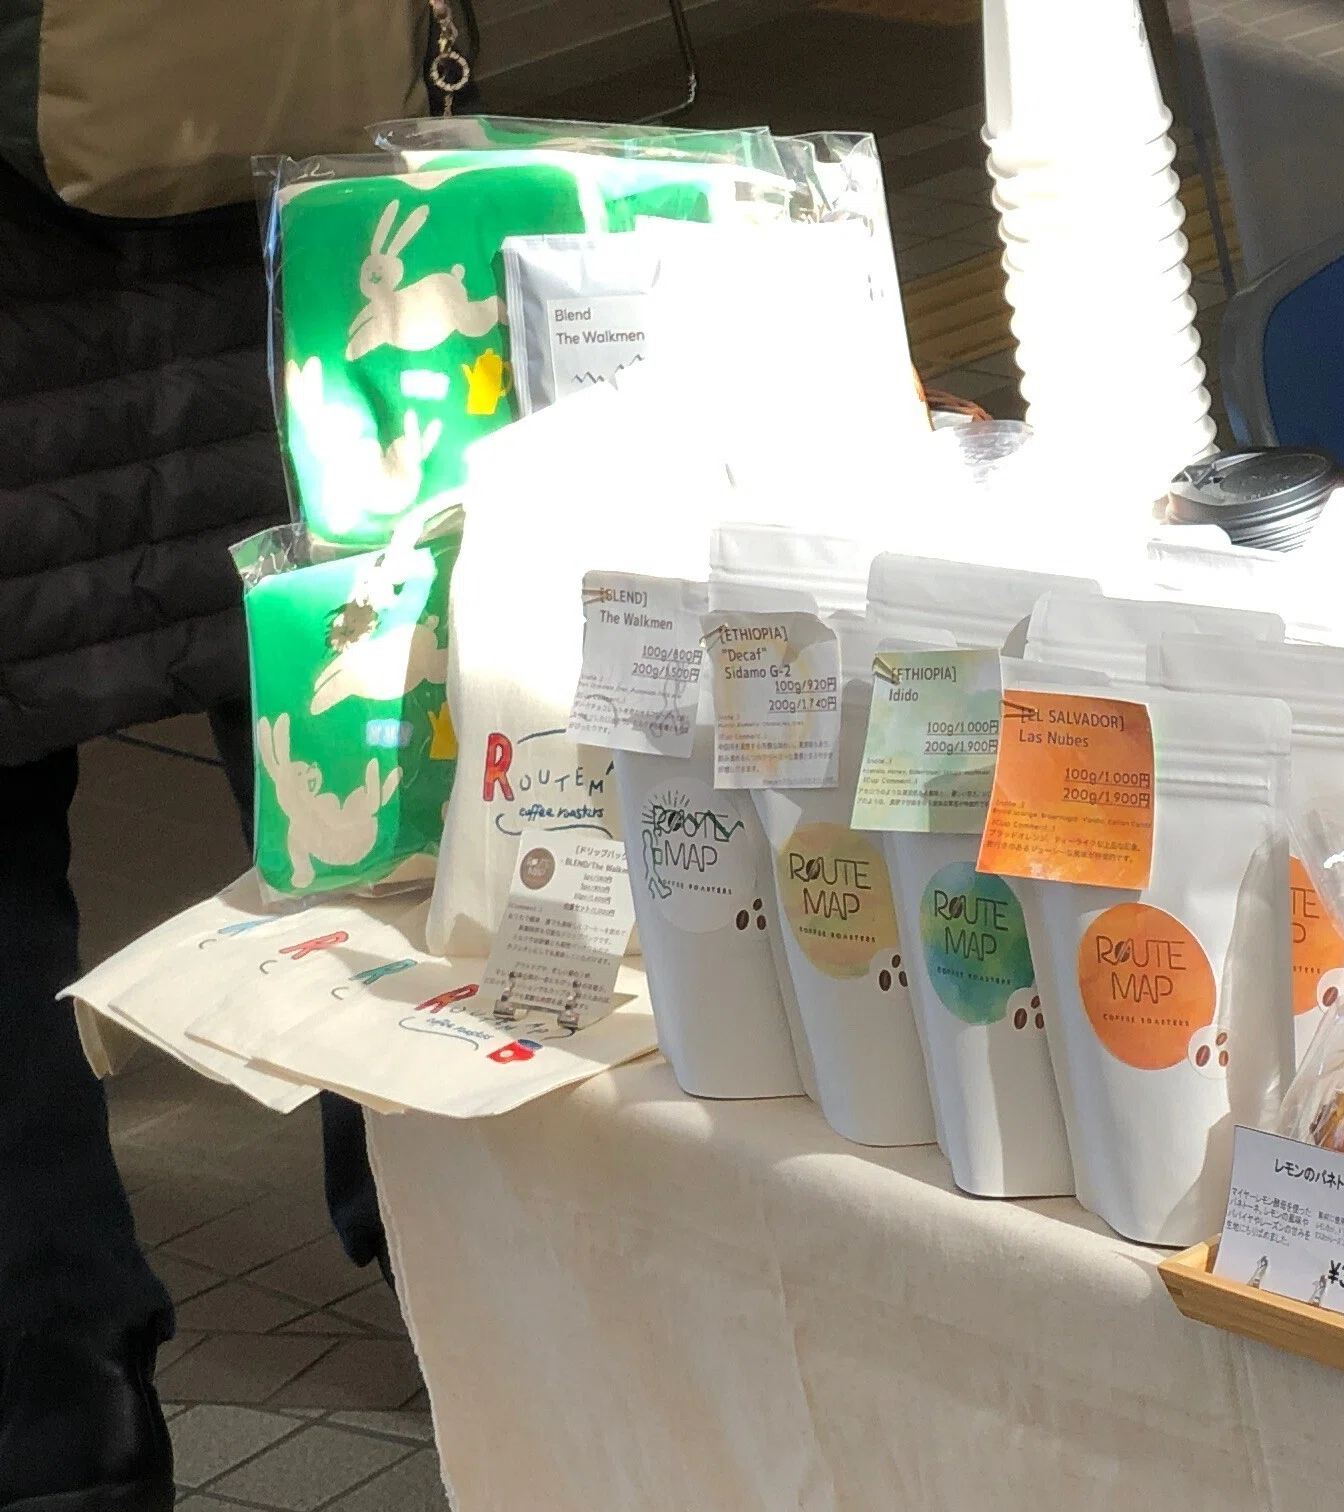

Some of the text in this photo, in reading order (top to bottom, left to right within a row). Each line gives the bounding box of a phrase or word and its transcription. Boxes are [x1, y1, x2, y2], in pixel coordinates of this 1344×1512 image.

[555, 307, 591, 322] Blend
[556, 330, 645, 345] The Walkmen
[600, 610, 673, 630] The Walkmen
[725, 665, 791, 679] Sidamo G-2
[889, 689, 919, 702] Idido
[1049, 710, 1124, 731] SALVADOR]
[1019, 729, 1089, 747] Las Nubes
[652, 804, 730, 842] ROUTE
[664, 840, 717, 872] MAP
[789, 852, 872, 890] ROUTE
[803, 888, 860, 920] MAP
[934, 890, 1009, 932] ROUTE
[944, 927, 997, 962] MAP
[1096, 935, 1187, 971] ROUTE
[1111, 972, 1173, 1004] MAP
